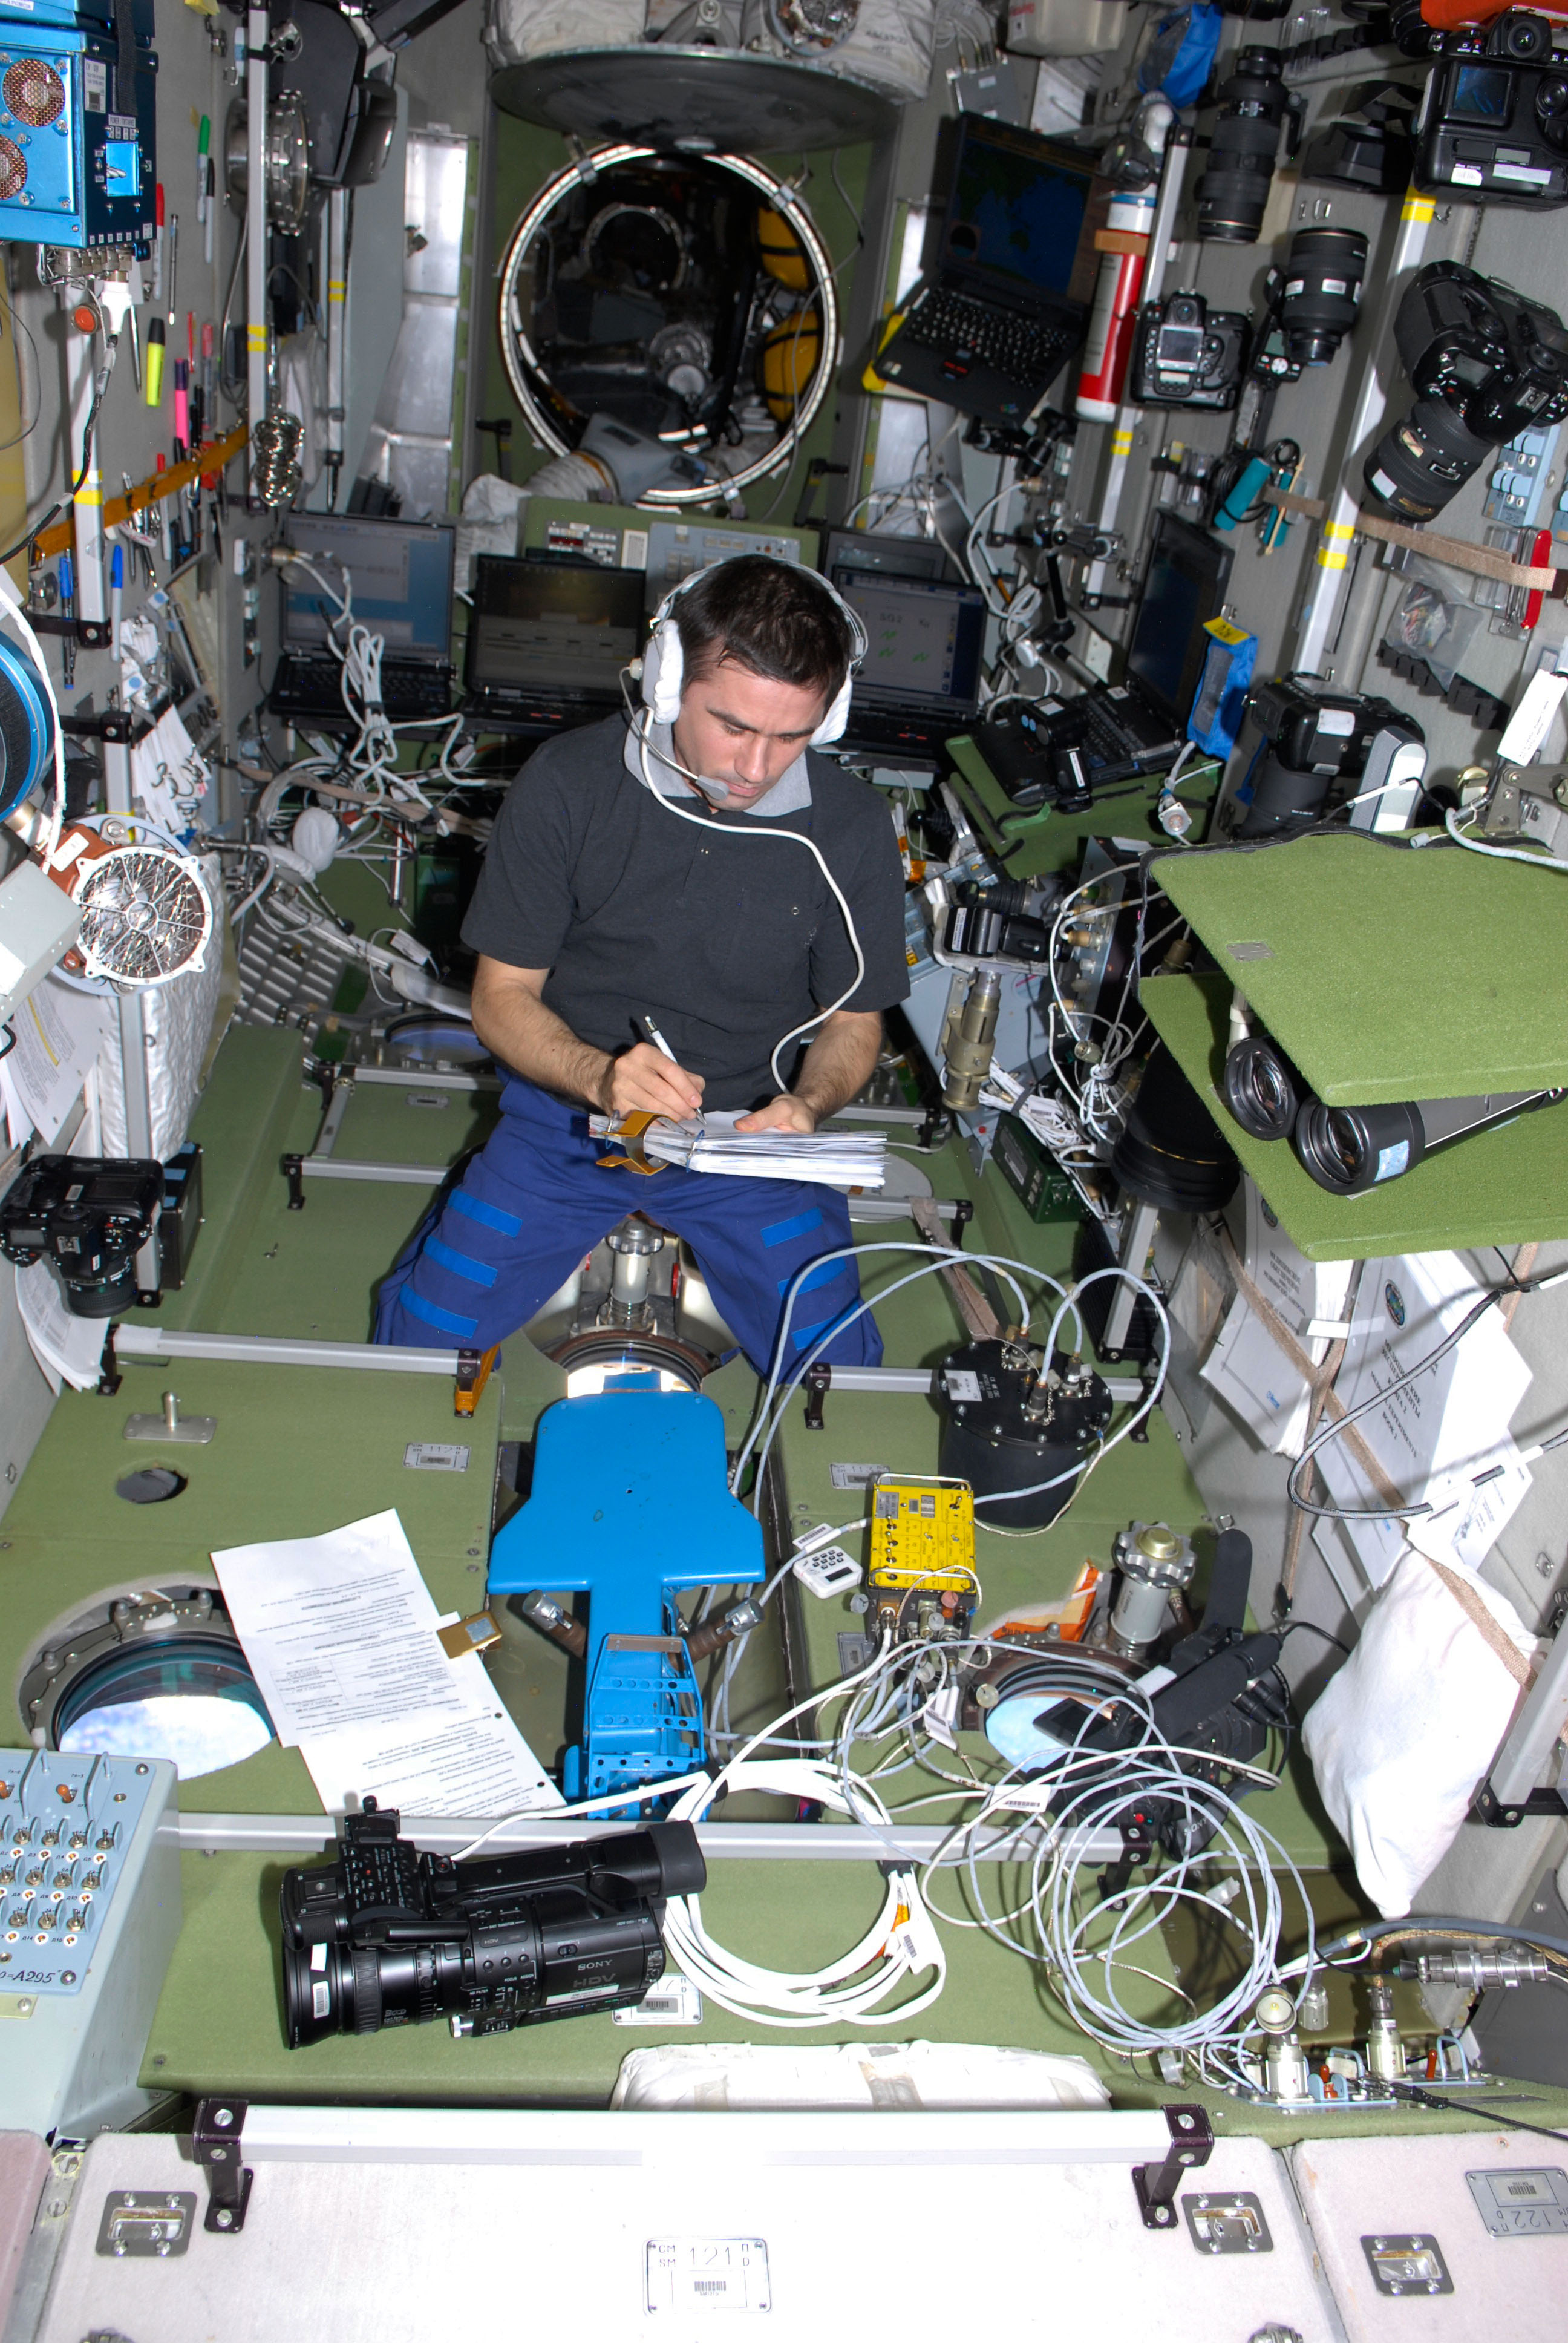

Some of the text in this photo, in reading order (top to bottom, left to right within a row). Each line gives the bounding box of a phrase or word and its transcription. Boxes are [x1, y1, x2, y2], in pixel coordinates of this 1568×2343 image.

[578, 1959, 613, 1971] SONY
[573, 1974, 616, 1987] HDV
[1511, 2210, 1551, 2229] 122
[690, 2247, 730, 2265] 121
[742, 2243, 749, 2252] П
[659, 2257, 750, 2267] SM D
